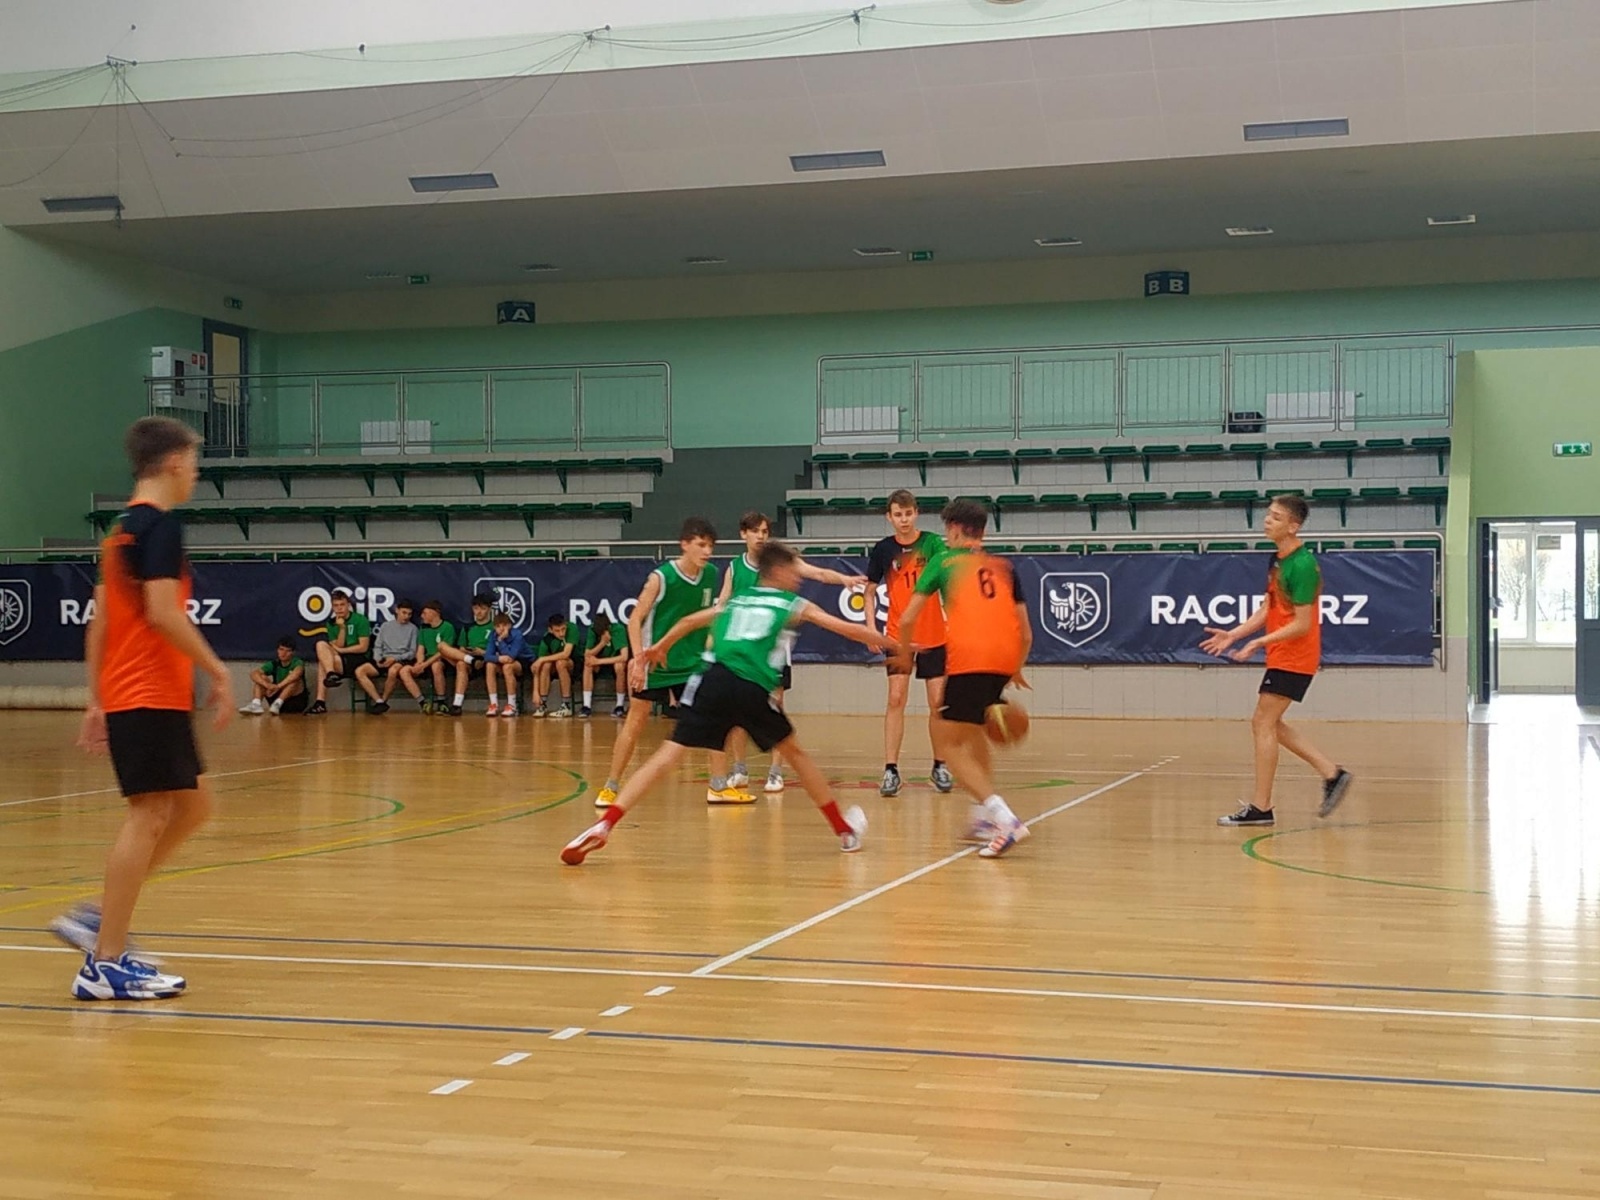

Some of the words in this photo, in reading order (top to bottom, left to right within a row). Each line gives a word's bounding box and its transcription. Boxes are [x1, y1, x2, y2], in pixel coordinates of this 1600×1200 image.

[1148, 280, 1160, 294] B
[1169, 278, 1184, 292] B
[511, 308, 531, 321] A
[903, 570, 917, 589] 11
[977, 567, 996, 599] 6
[1150, 594, 1370, 625] RACIRZ
